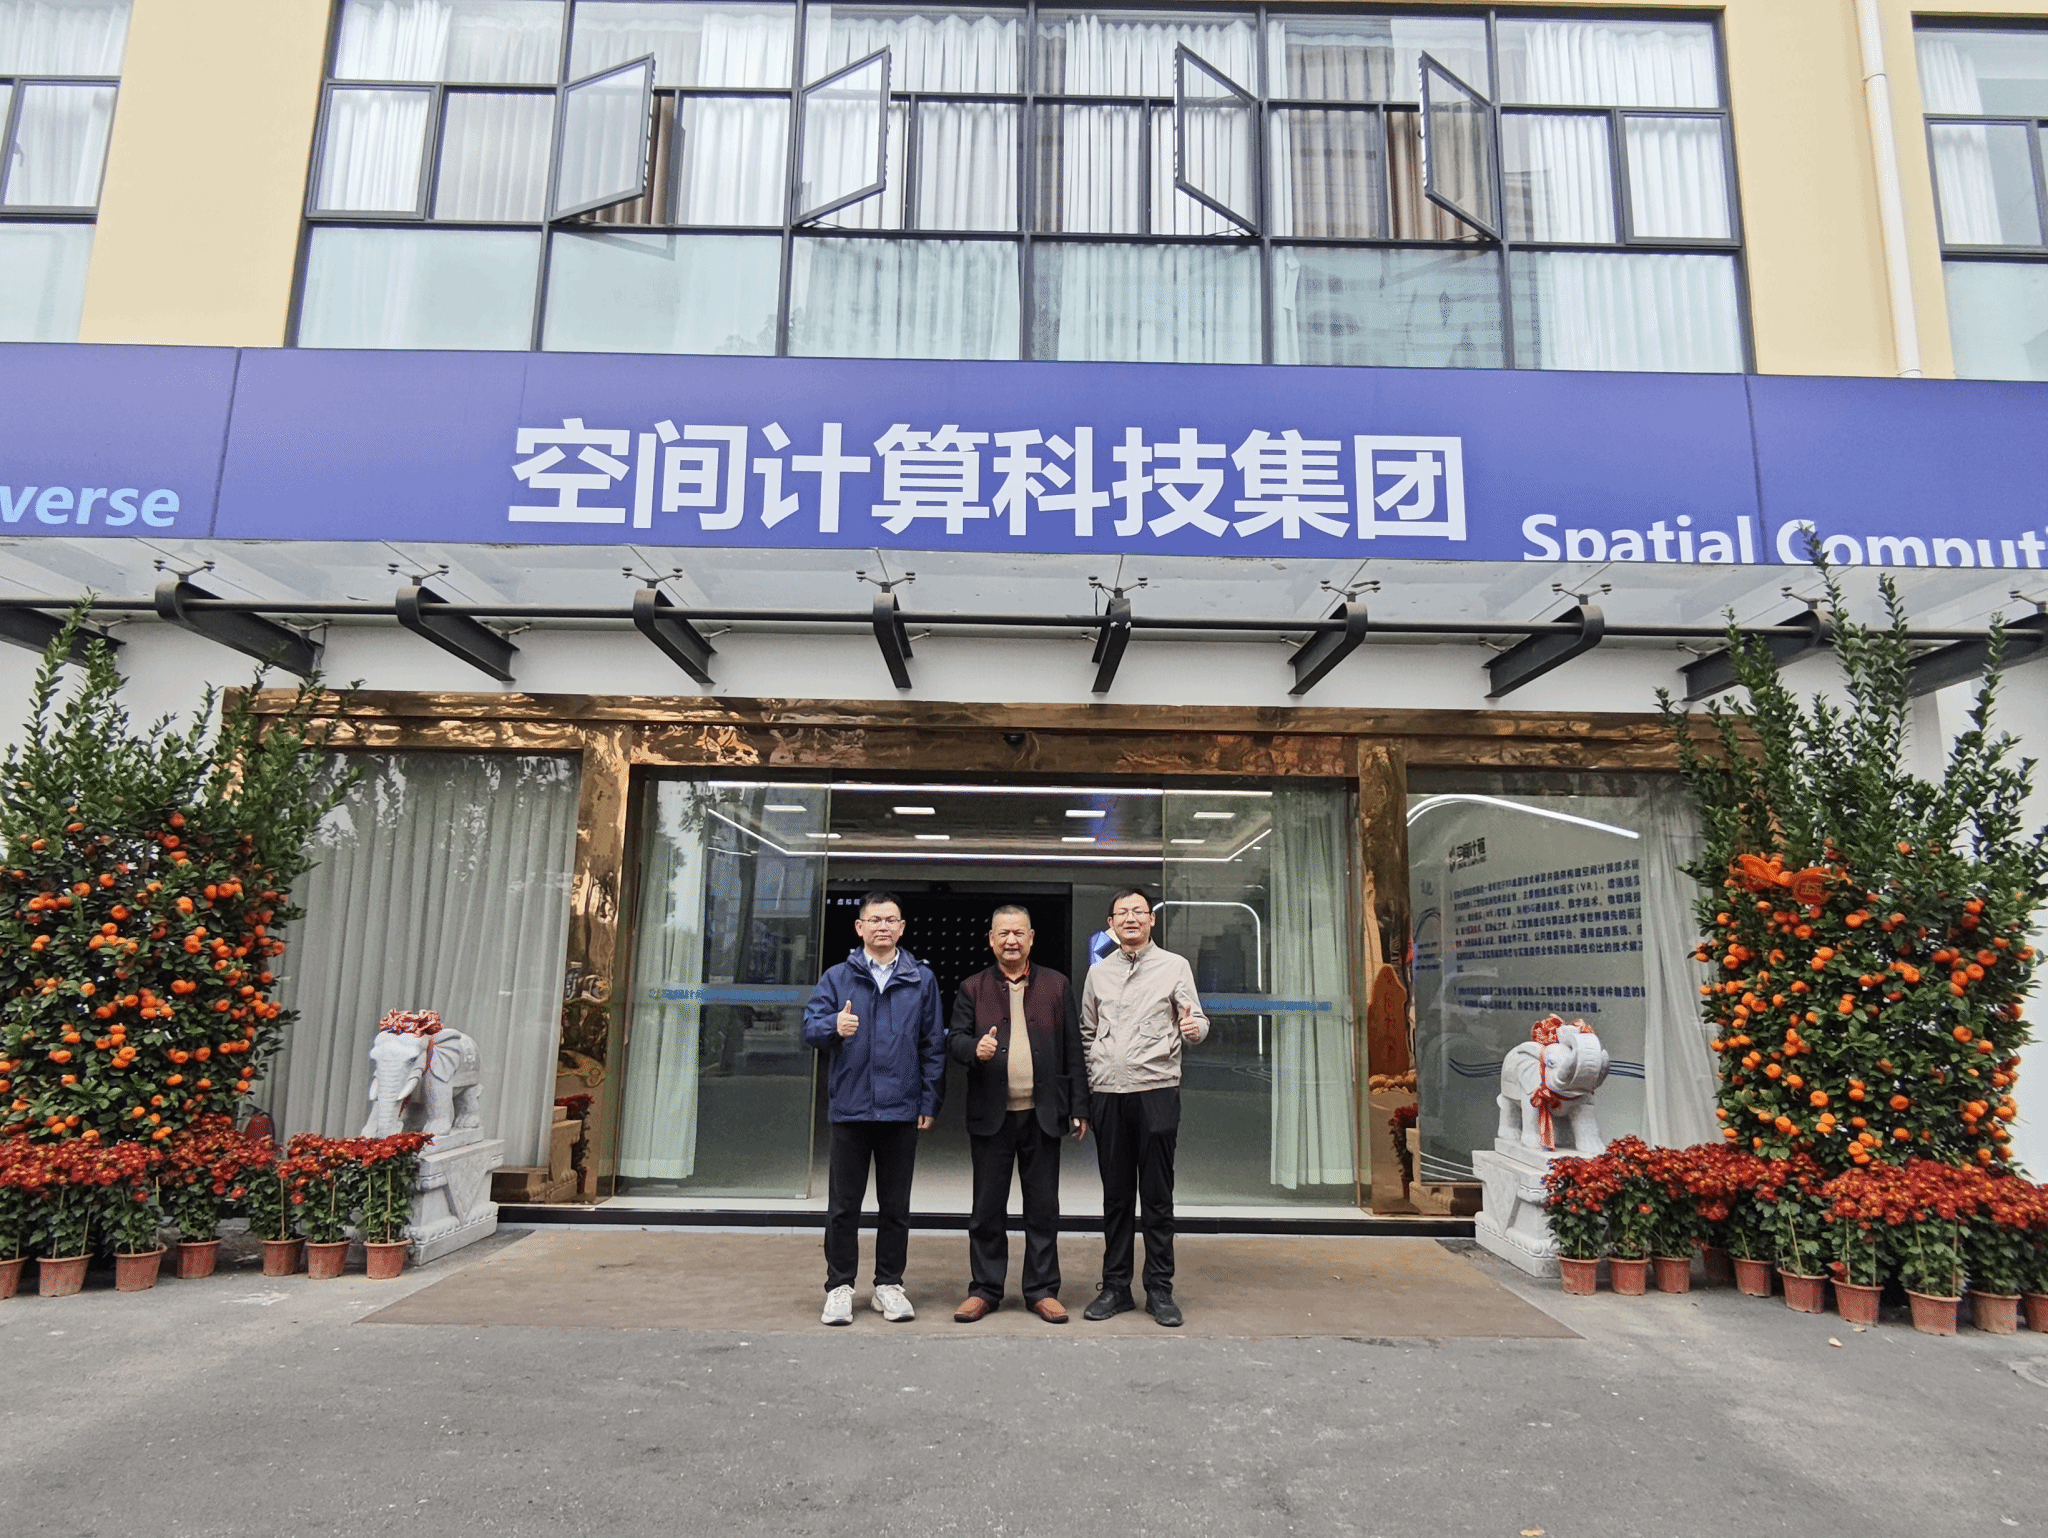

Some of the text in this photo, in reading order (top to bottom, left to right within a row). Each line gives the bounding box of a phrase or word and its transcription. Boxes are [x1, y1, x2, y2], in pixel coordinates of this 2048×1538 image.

[507, 418, 1468, 541] 空间计算科技集团
[1522, 513, 2048, 568] Spatial Comput
